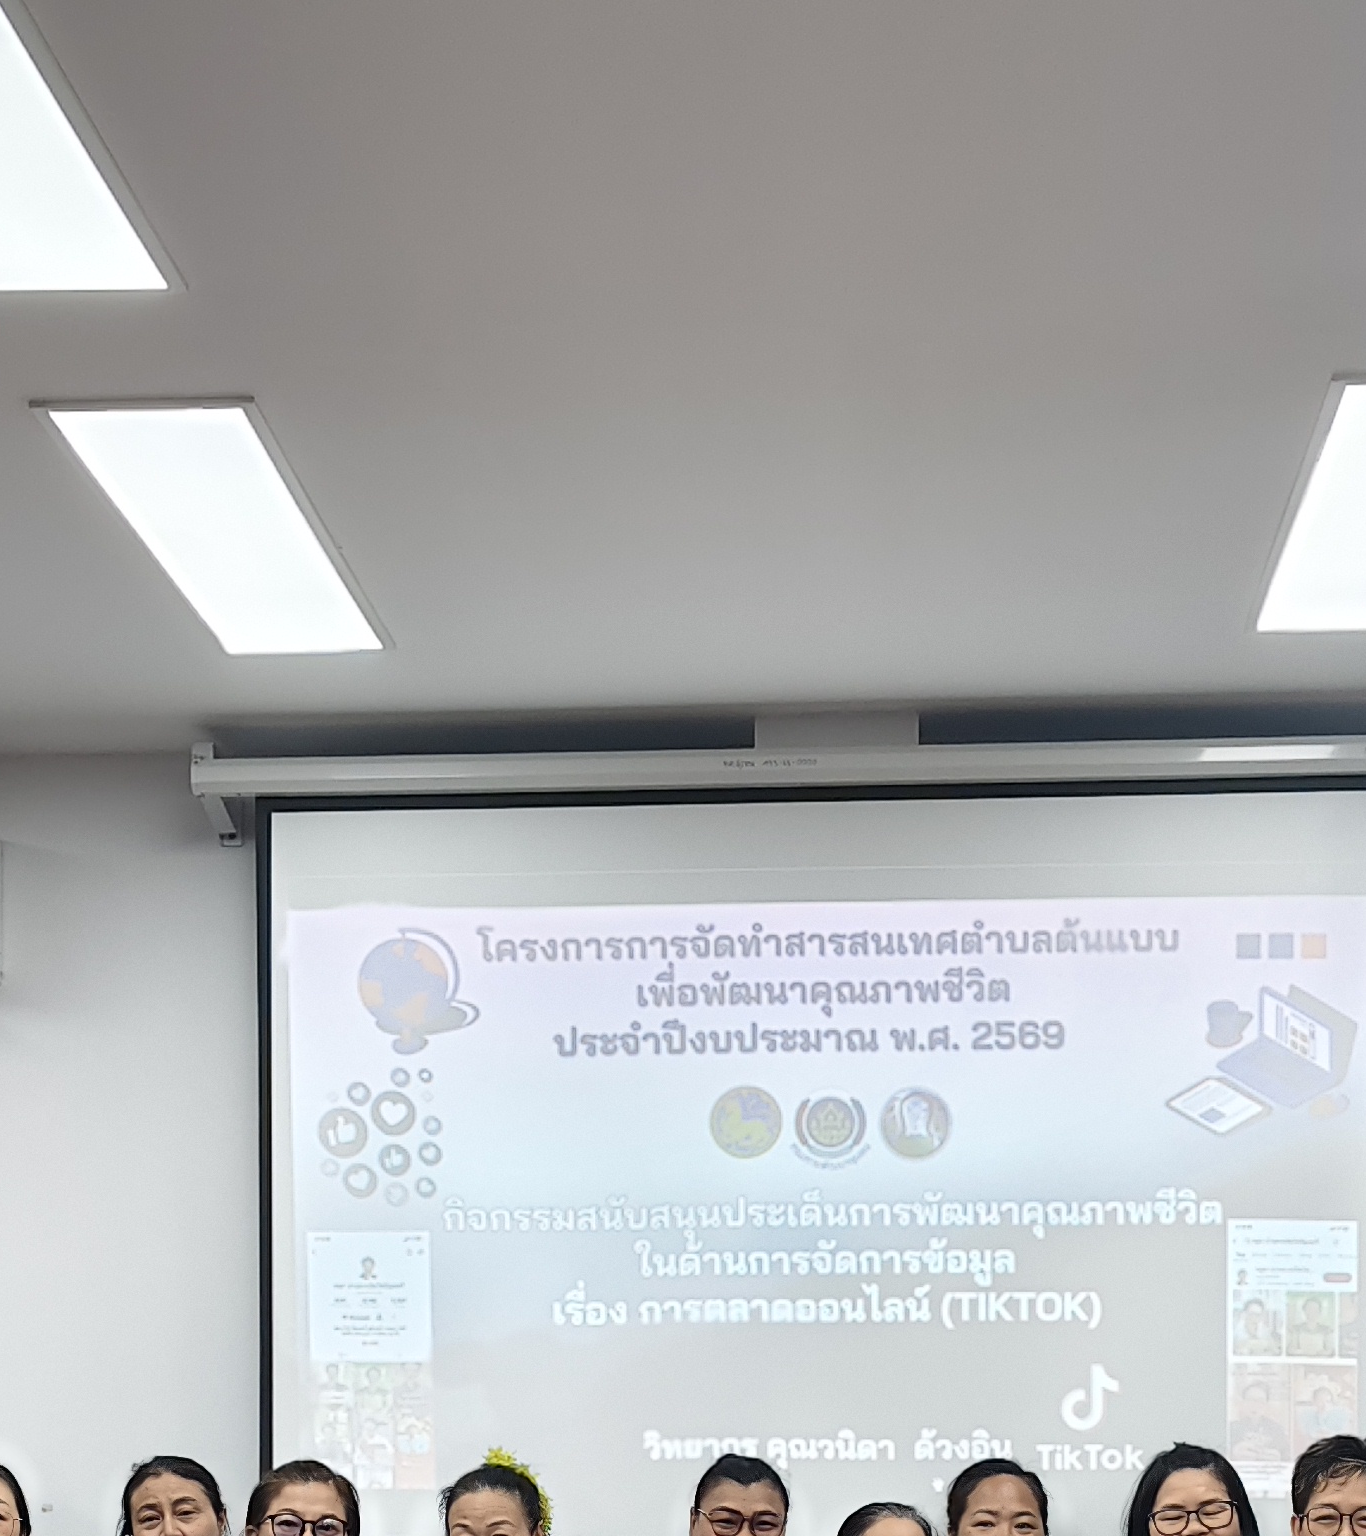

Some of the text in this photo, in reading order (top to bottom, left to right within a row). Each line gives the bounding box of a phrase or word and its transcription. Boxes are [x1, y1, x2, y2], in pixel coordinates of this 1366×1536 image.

[476, 917, 1180, 963] โครงการการจัดทำสารสนเทศตำบลต้นแบบ
[636, 962, 1011, 1018] เพื่อพัฒนาคุณภาพชีวิต
[552, 1019, 1065, 1057] ประจำปีงบประมาณ พ.ศ. 2569
[442, 1187, 1223, 1239] กิจกรรมสนับสนุนประเด็นการพัฒนาคุณภาพชีวิต
[634, 1231, 1016, 1287] ในด้านการจัดการข้อมูล
[552, 1280, 1103, 1330] เรื่อง การตลาดออนไลน์ (TIKTOK)
[1036, 1442, 1146, 1472] TikTok
